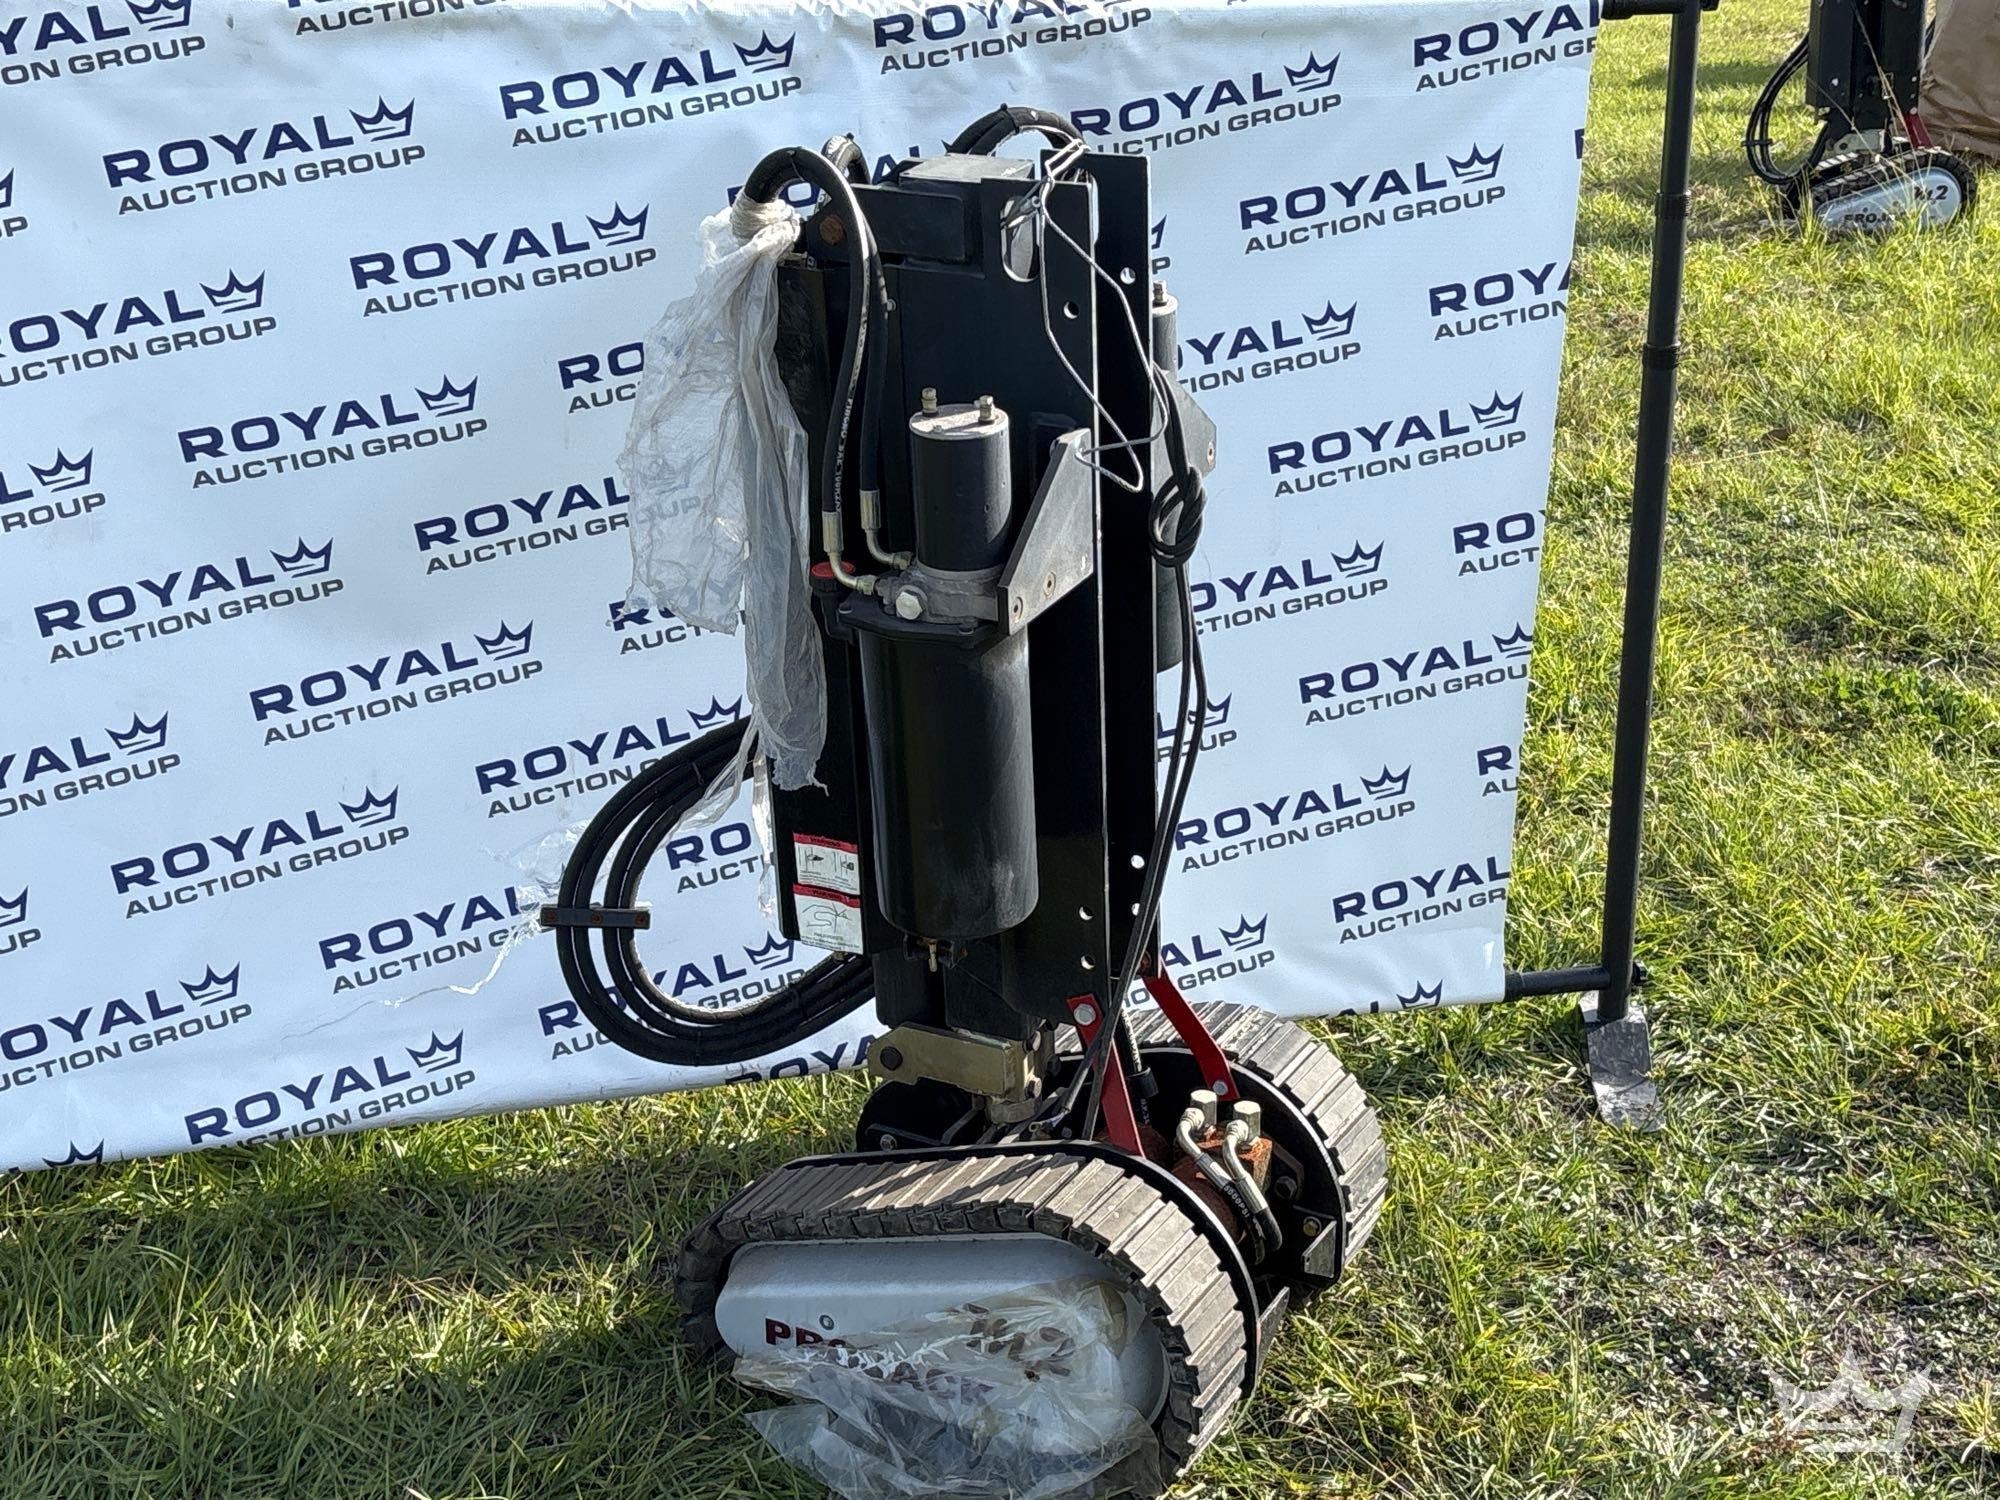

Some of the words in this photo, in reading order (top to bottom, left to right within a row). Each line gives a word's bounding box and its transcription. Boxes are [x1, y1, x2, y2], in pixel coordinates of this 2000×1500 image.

[67, 36, 206, 74] GROUP
[880, 31, 1028, 75] AUCTION
[1035, 7, 1152, 44] GROUP
[1415, 44, 1556, 92] AUCTION
[499, 49, 737, 120] ROYAL
[512, 102, 674, 148] AUCTION
[680, 76, 802, 117] GROUP
[1069, 72, 1284, 136] ROYAL
[1227, 93, 1342, 132] GROUP
[102, 115, 355, 188] ROYAL
[118, 167, 287, 216] AUCTION
[294, 145, 426, 183] GROUP
[1239, 161, 1448, 231] ROYAL
[1245, 209, 1386, 255] AUCTION
[1393, 185, 1506, 222] GROUP
[349, 221, 591, 290] ROYAL
[363, 272, 526, 318] AUCTION
[532, 247, 657, 287] GROUP
[0, 288, 206, 358] OYAL
[145, 316, 277, 356] GROUP
[1177, 319, 1304, 371] YAL
[1251, 342, 1361, 379] GROUP
[177, 393, 420, 463] ROYAL
[192, 443, 355, 489] AUCTION
[361, 418, 488, 457] GROUP
[1267, 409, 1470, 475] ROYAL
[1274, 454, 1411, 498] AUCTION
[1418, 430, 1526, 466] GROUP
[413, 476, 631, 552] ROYAL
[426, 524, 578, 575] AUCTION
[33, 556, 276, 639] ROYAL
[50, 607, 212, 664] AUCTION
[218, 578, 344, 620] GROUP
[1282, 578, 1388, 615] GROUP
[249, 641, 479, 722] ROYAL
[264, 691, 418, 747] AUCTION
[424, 660, 543, 703] GROUP
[1298, 639, 1493, 704] ROYAL
[1305, 682, 1437, 726] AUCTION
[53, 754, 181, 801] GROUP
[475, 716, 691, 795] ROYAL
[486, 764, 645, 819] AUCTION
[1175, 781, 1362, 851] ROYAL
[110, 809, 344, 895] ROYAL
[1182, 826, 1309, 873] AUCTION
[1315, 800, 1416, 838] GROUP
[126, 861, 283, 919] AUCTION
[288, 826, 410, 872] GROUP
[1332, 855, 1512, 923] ROYAL
[1339, 898, 1463, 944] AUCTION
[333, 936, 482, 995] AUCTION
[1177, 950, 1275, 991] GROUP
[128, 1003, 252, 1053] GROUP
[184, 1056, 412, 1146] ROYAL
[358, 1070, 476, 1120] GROUP
